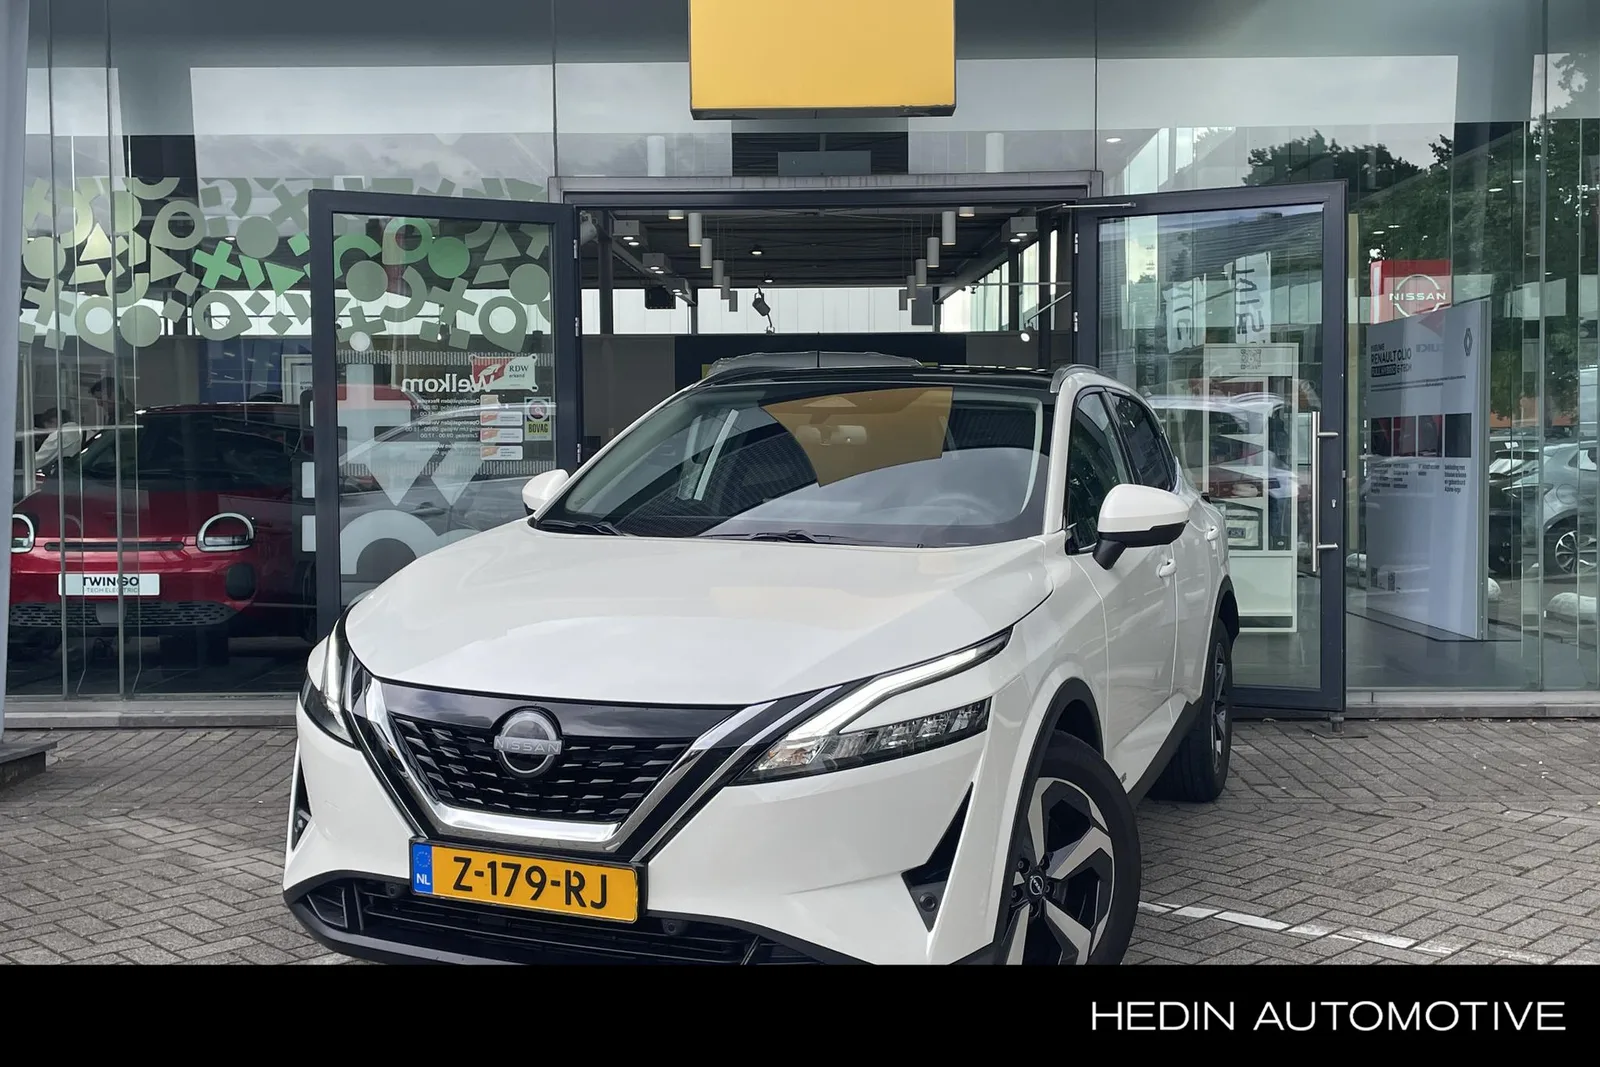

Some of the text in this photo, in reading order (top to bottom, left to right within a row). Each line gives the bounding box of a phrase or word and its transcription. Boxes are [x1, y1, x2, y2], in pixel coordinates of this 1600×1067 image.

[1389, 292, 1446, 301] NISSAN
[528, 423, 549, 434] BOVAG
[83, 576, 139, 587] TWINGO
[495, 738, 560, 753] NISSAN
[416, 872, 431, 886] NL
[452, 856, 608, 910] Z-179-RJ
